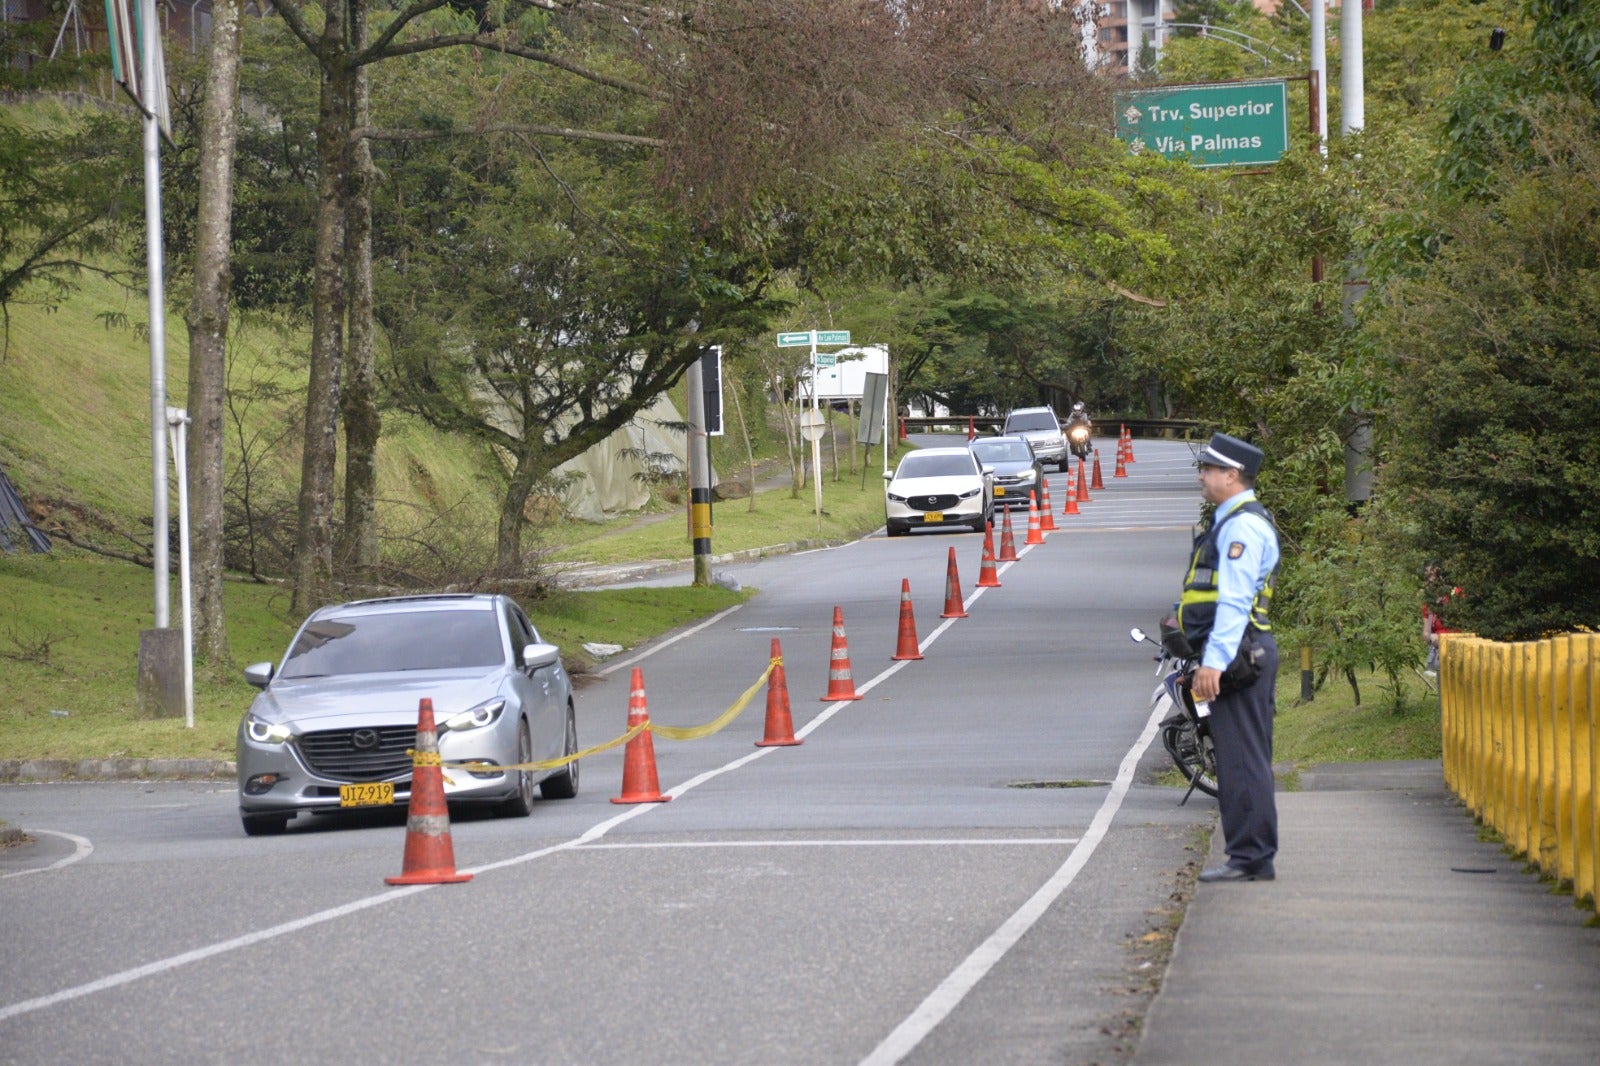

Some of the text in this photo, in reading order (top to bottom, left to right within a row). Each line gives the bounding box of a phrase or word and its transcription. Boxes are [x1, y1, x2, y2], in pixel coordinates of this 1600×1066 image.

[1148, 100, 1274, 122] Trv. Superior
[1191, 133, 1262, 151] Palmas
